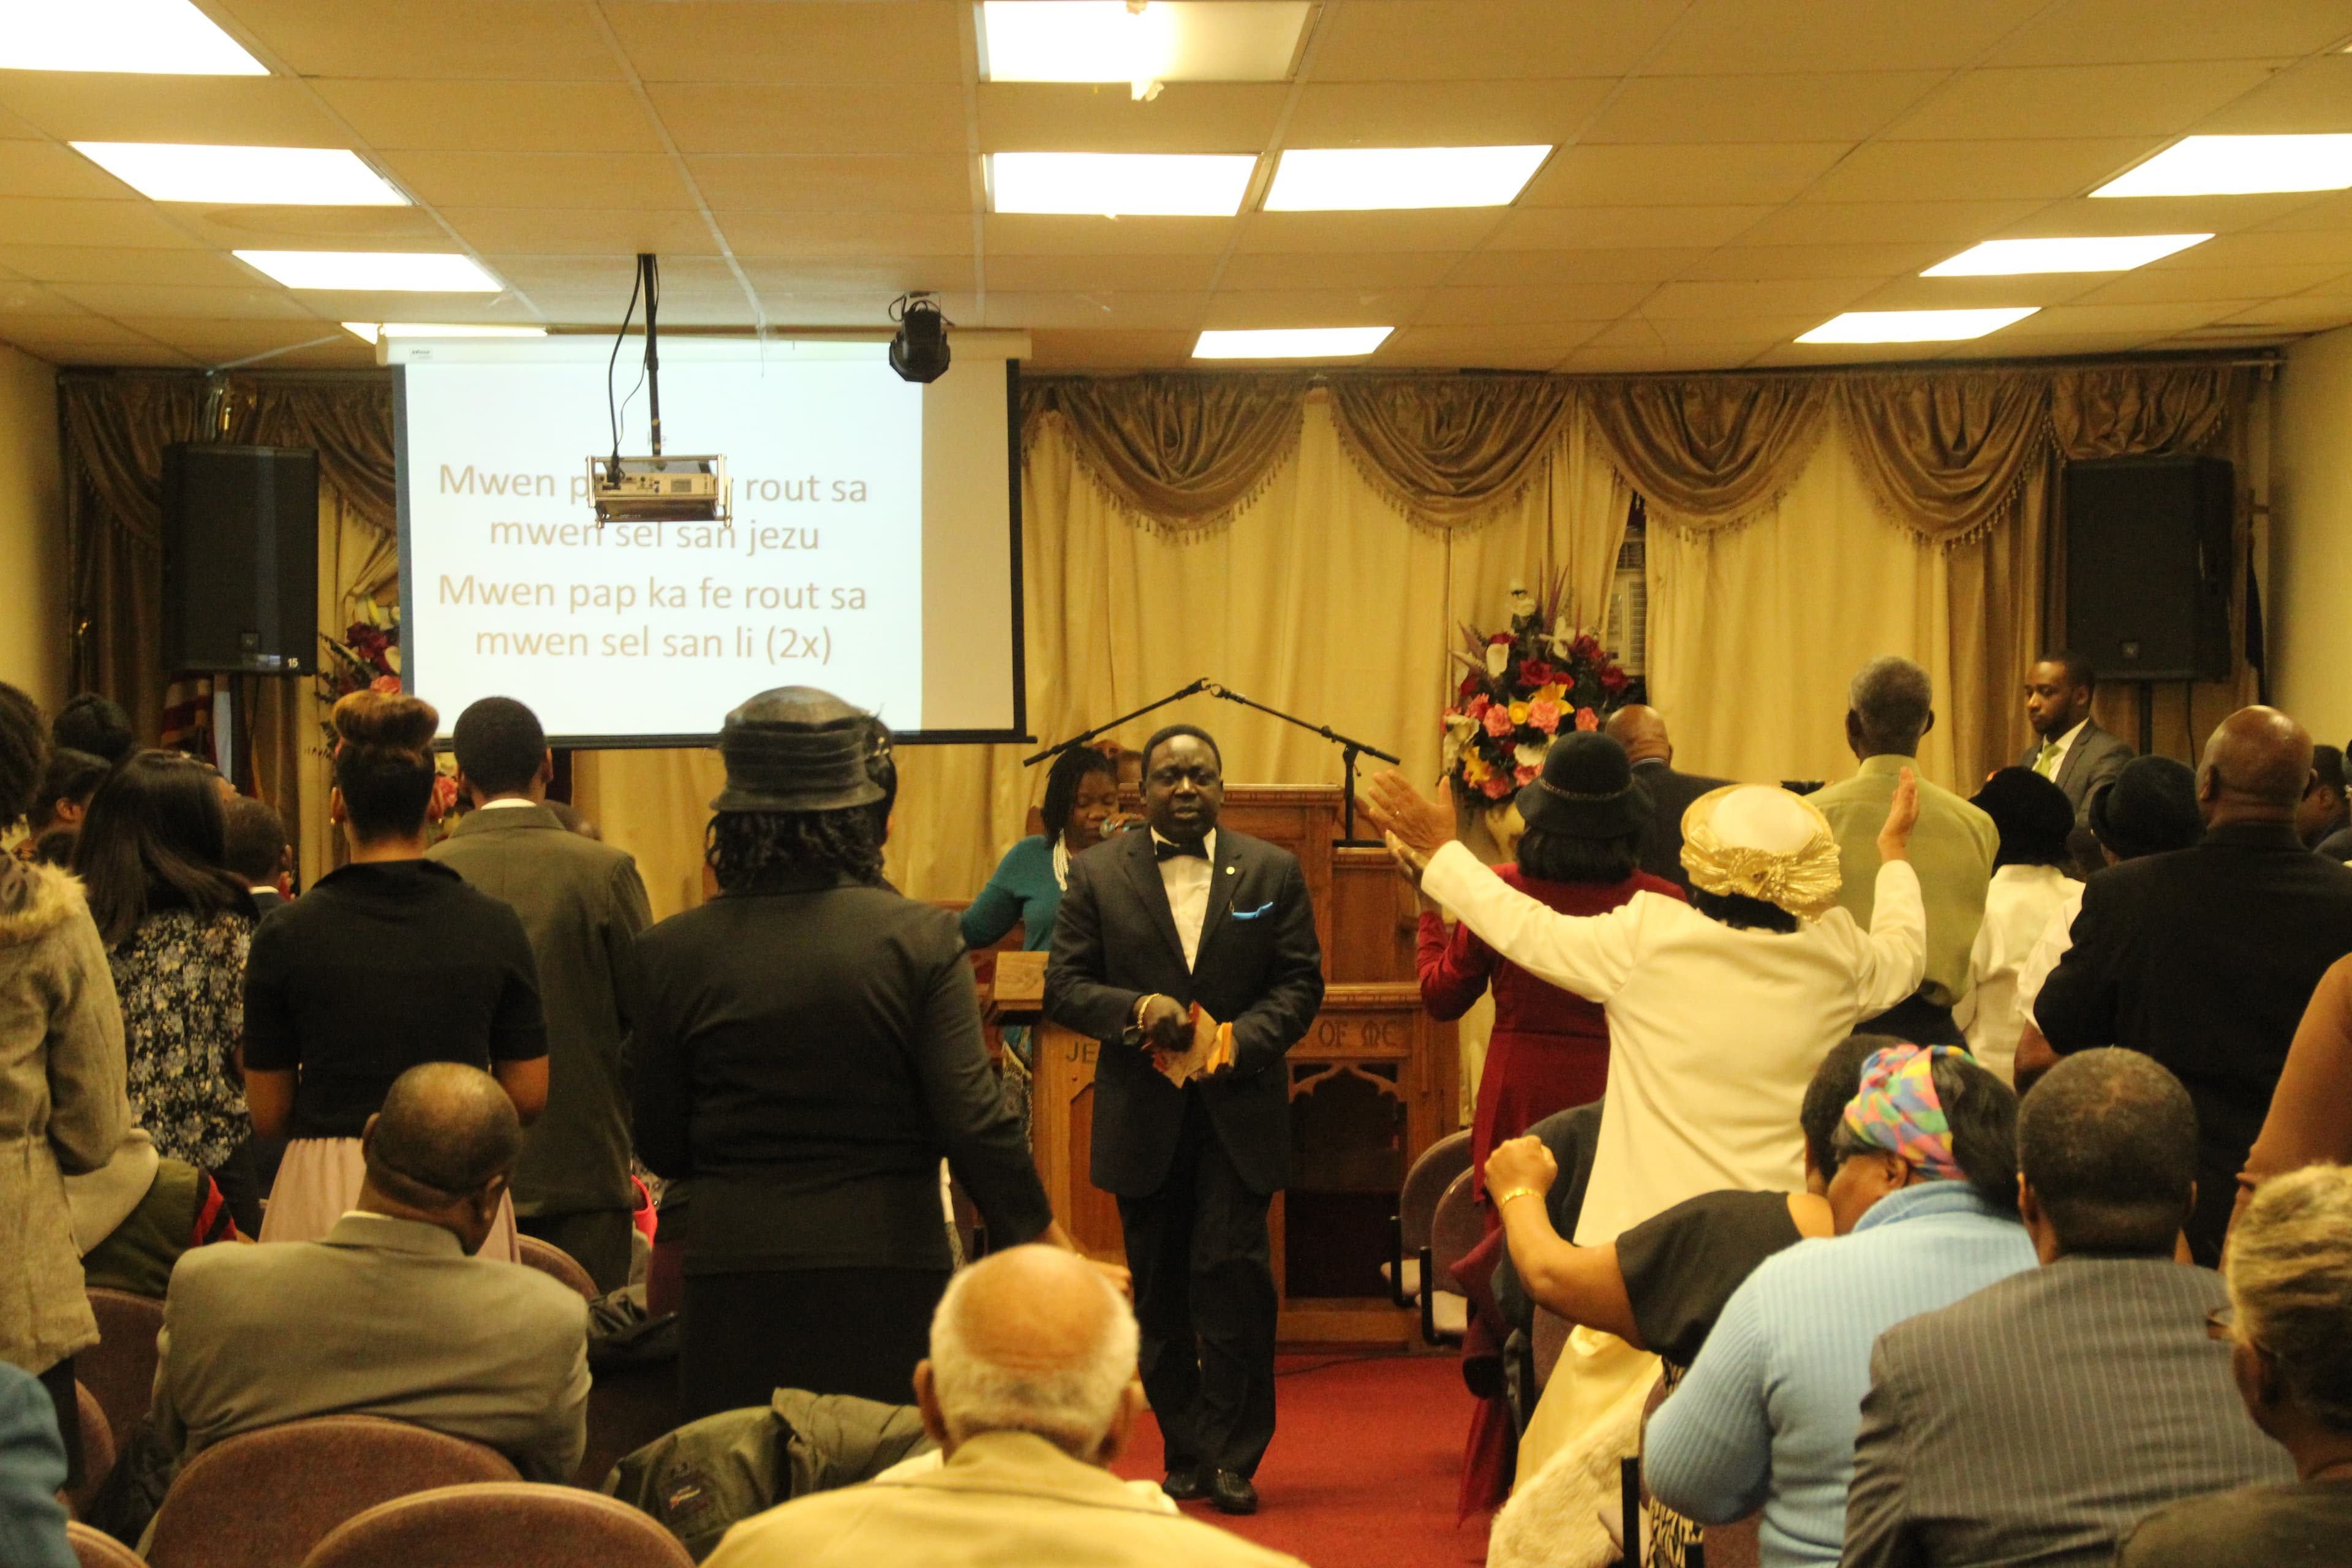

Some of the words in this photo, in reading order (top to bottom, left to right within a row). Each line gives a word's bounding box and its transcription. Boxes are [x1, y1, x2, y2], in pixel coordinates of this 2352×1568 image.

[439, 463, 555, 497] Mwen
[745, 475, 820, 502] rout
[832, 480, 867, 503] sa
[490, 521, 603, 547] mwen
[616, 519, 662, 548] sel
[676, 526, 736, 549] san
[745, 519, 819, 557] jezu
[439, 573, 555, 606] Mwen
[570, 584, 636, 615] pap
[649, 576, 687, 608] ka
[698, 576, 732, 609] fe
[745, 582, 820, 610] rout
[831, 587, 866, 611] sa
[288, 657, 298, 668] 15
[475, 631, 589, 657] mwen
[601, 625, 649, 657] sel
[663, 634, 723, 658] san
[736, 625, 752, 658] li
[766, 625, 832, 666] (2x)
[1318, 1019, 1348, 1048] OF
